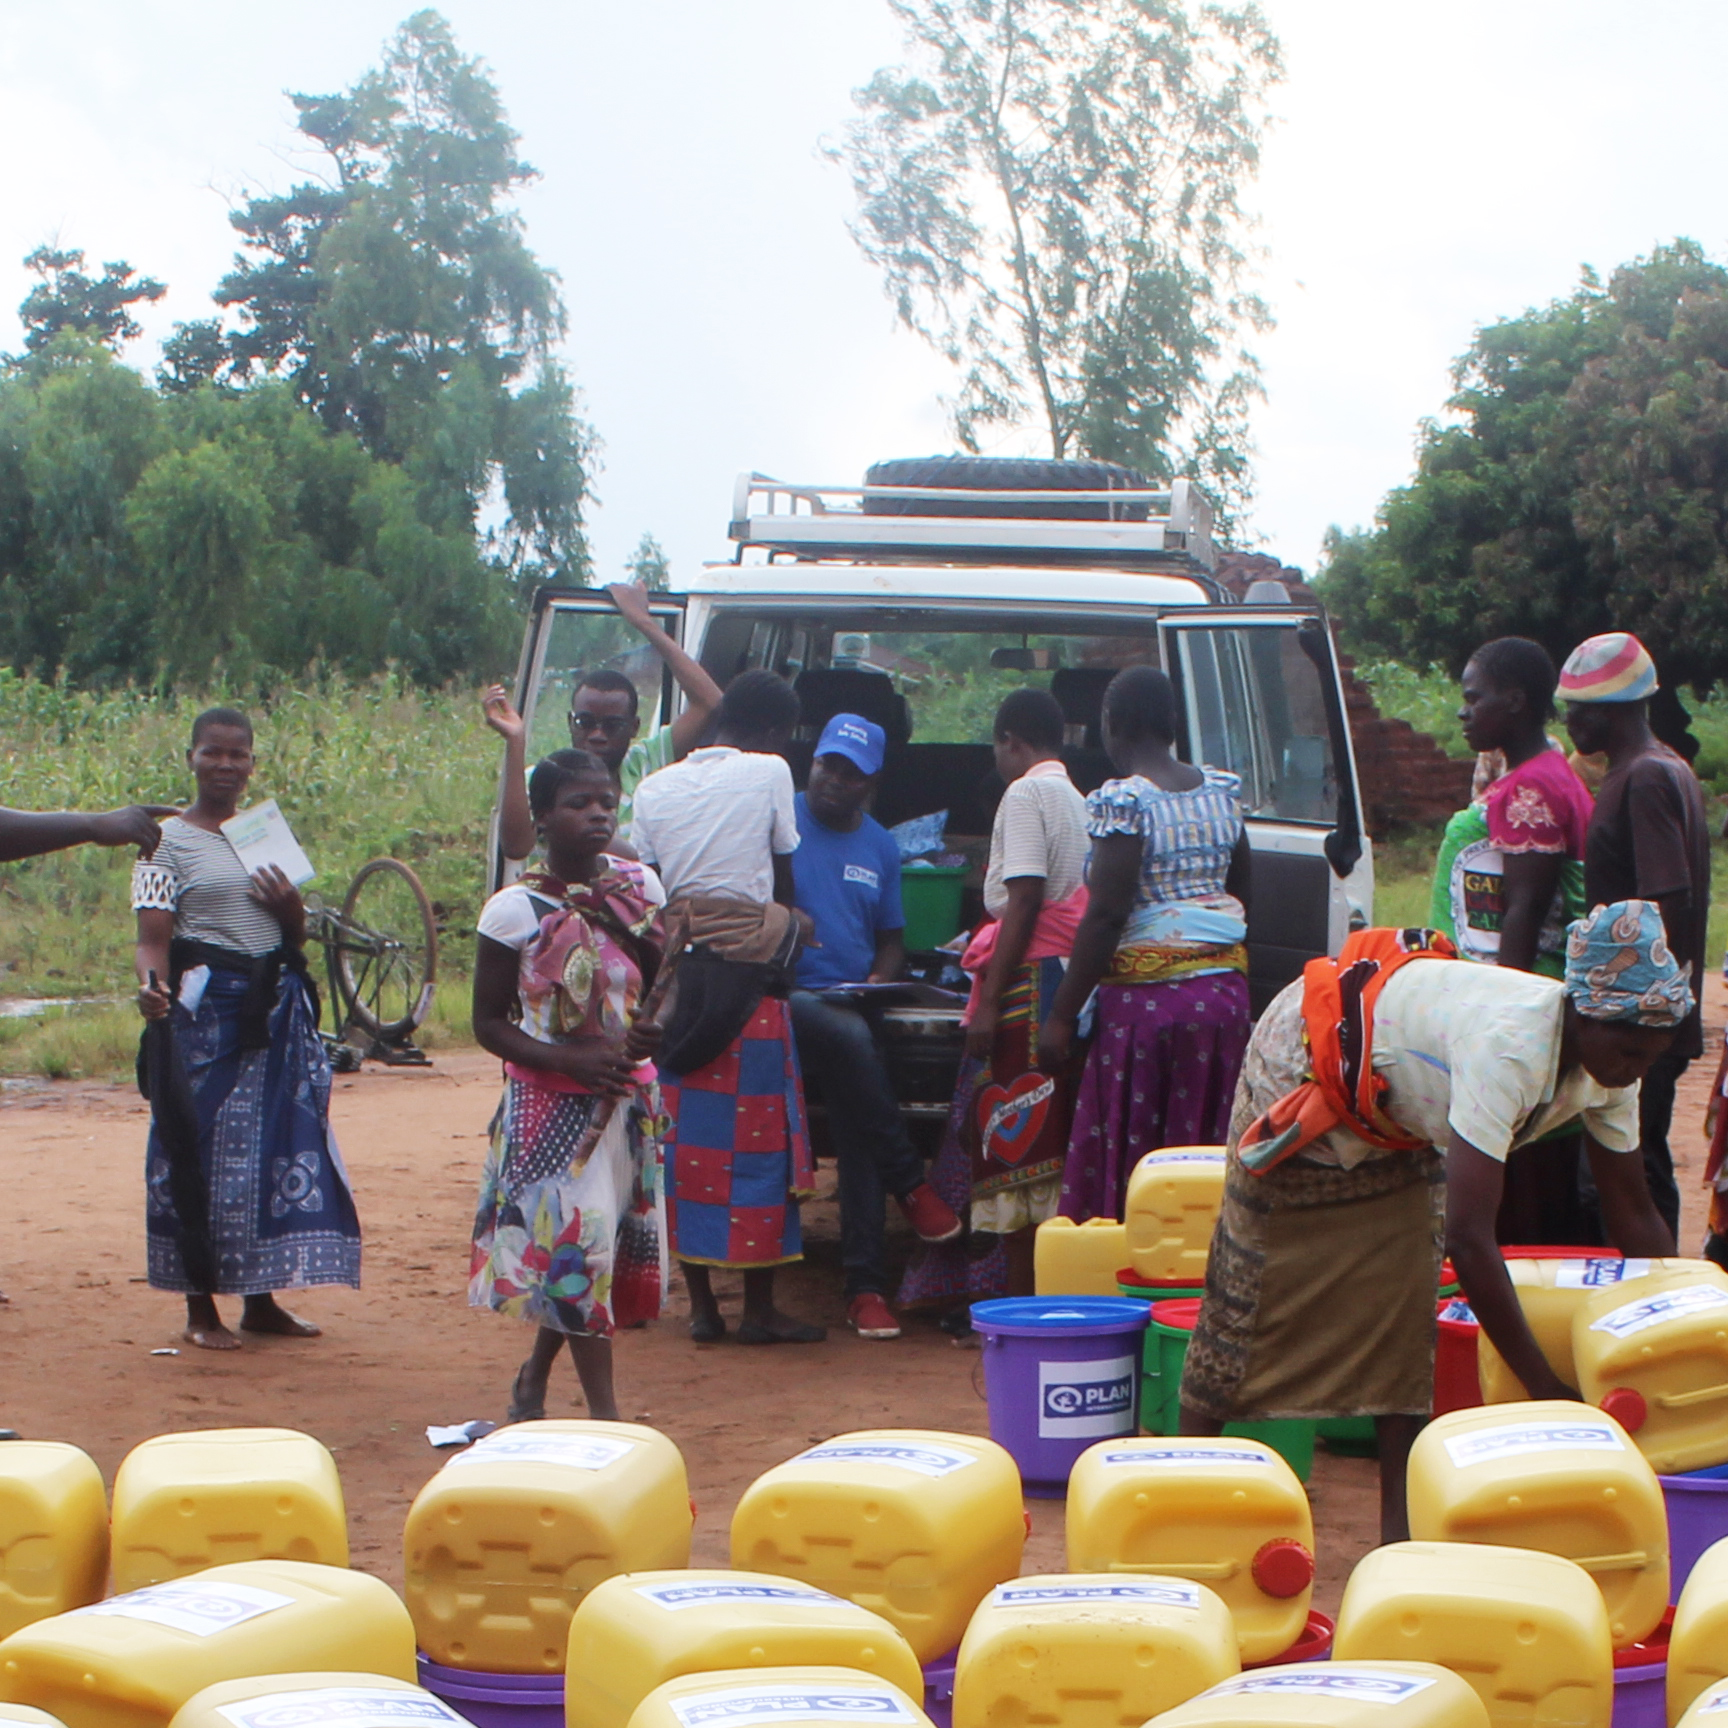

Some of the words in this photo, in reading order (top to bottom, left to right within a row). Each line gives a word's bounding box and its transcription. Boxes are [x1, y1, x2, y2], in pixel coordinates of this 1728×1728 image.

[1086, 1383, 1130, 1405] PLAN
[324, 1699, 438, 1716] PLAN
[695, 1700, 805, 1718] PLAN
